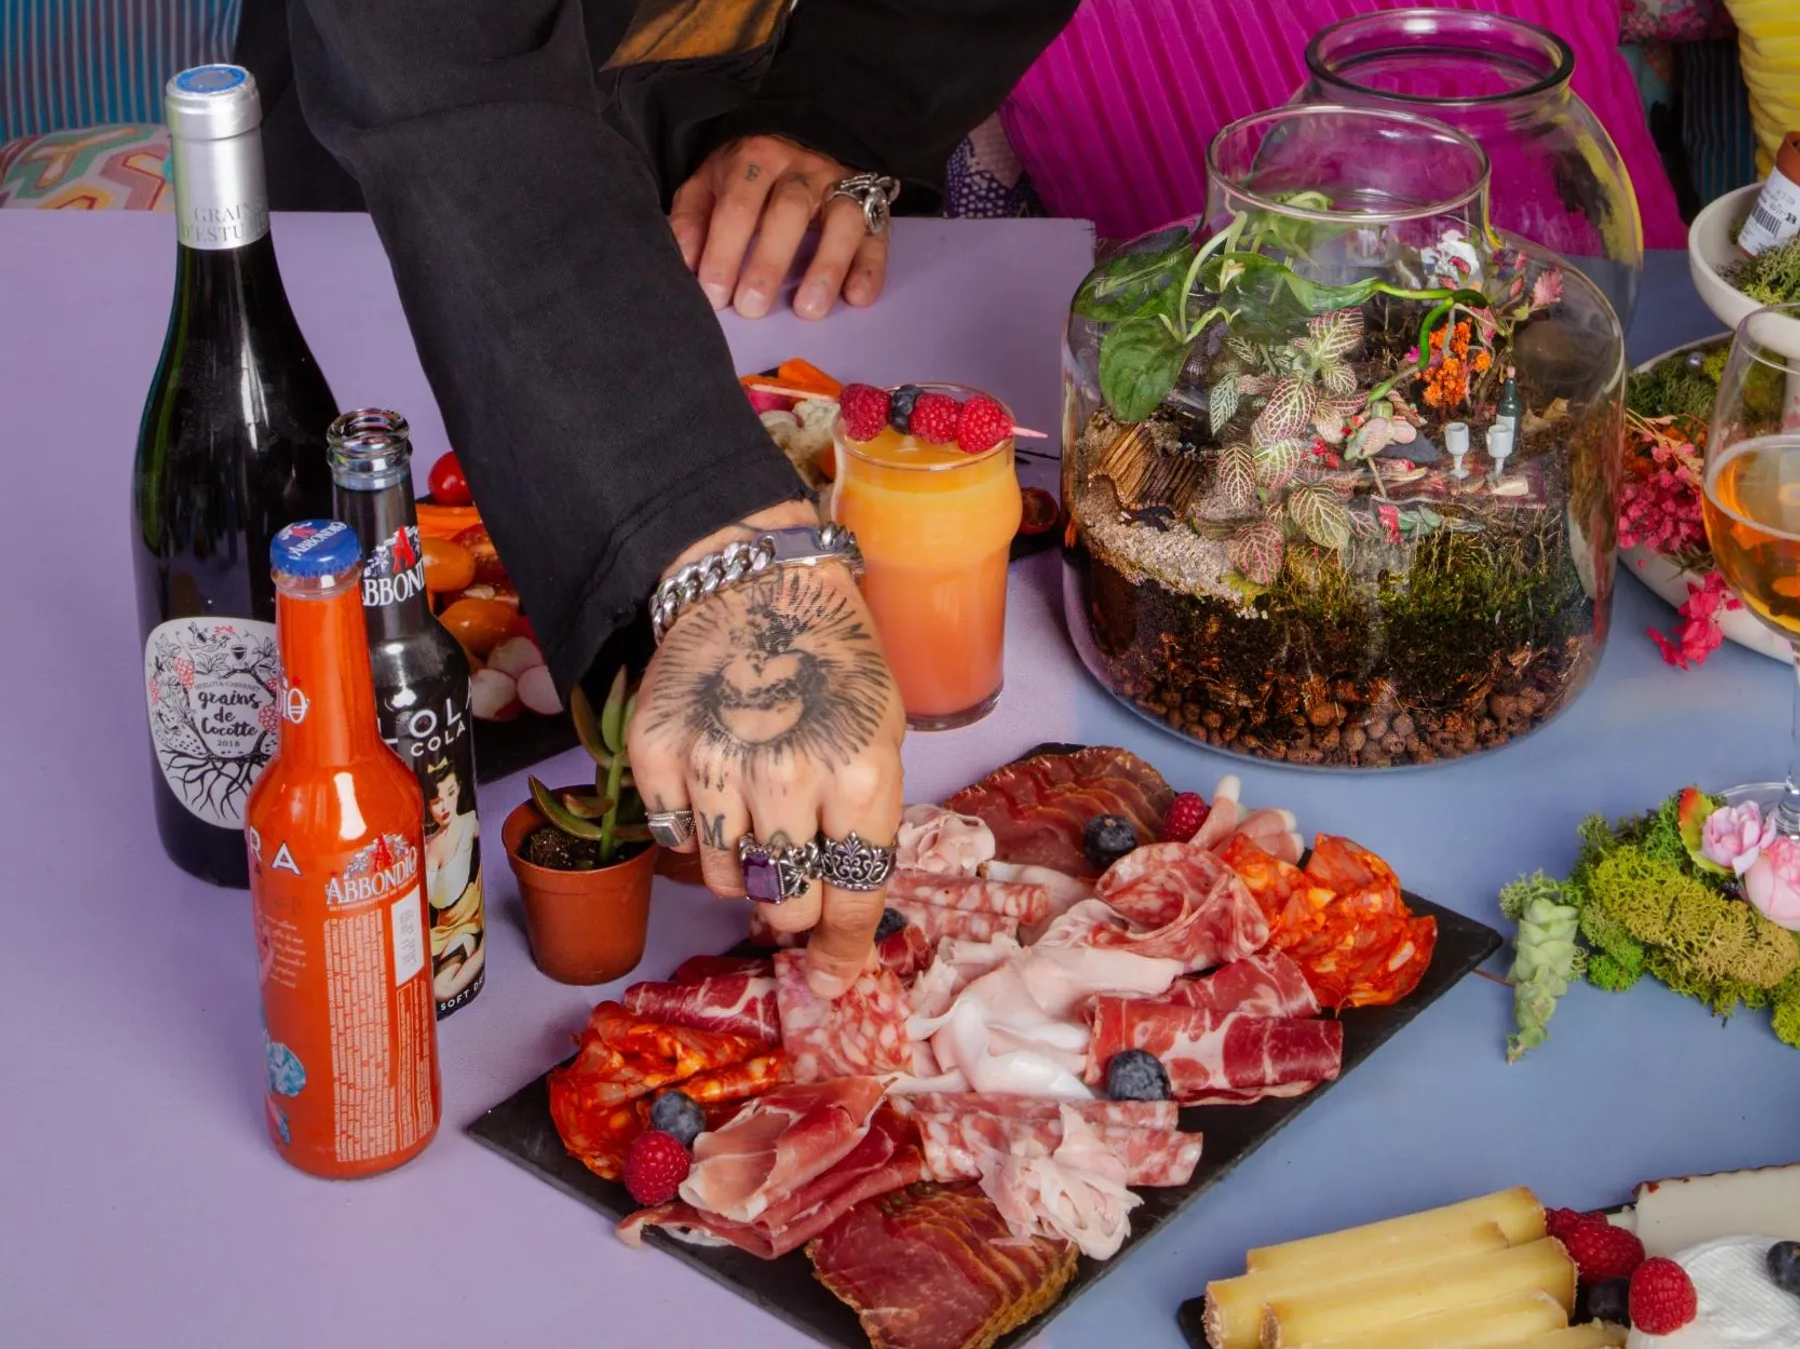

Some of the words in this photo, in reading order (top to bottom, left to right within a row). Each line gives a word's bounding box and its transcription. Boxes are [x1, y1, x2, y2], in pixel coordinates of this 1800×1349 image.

[198, 690, 262, 710] grains
[213, 706, 236, 723] de
[201, 716, 258, 737] Cocotte
[411, 719, 466, 757] COLA
[324, 846, 418, 906] ABBONDIO
[440, 989, 470, 1011] SOFT
